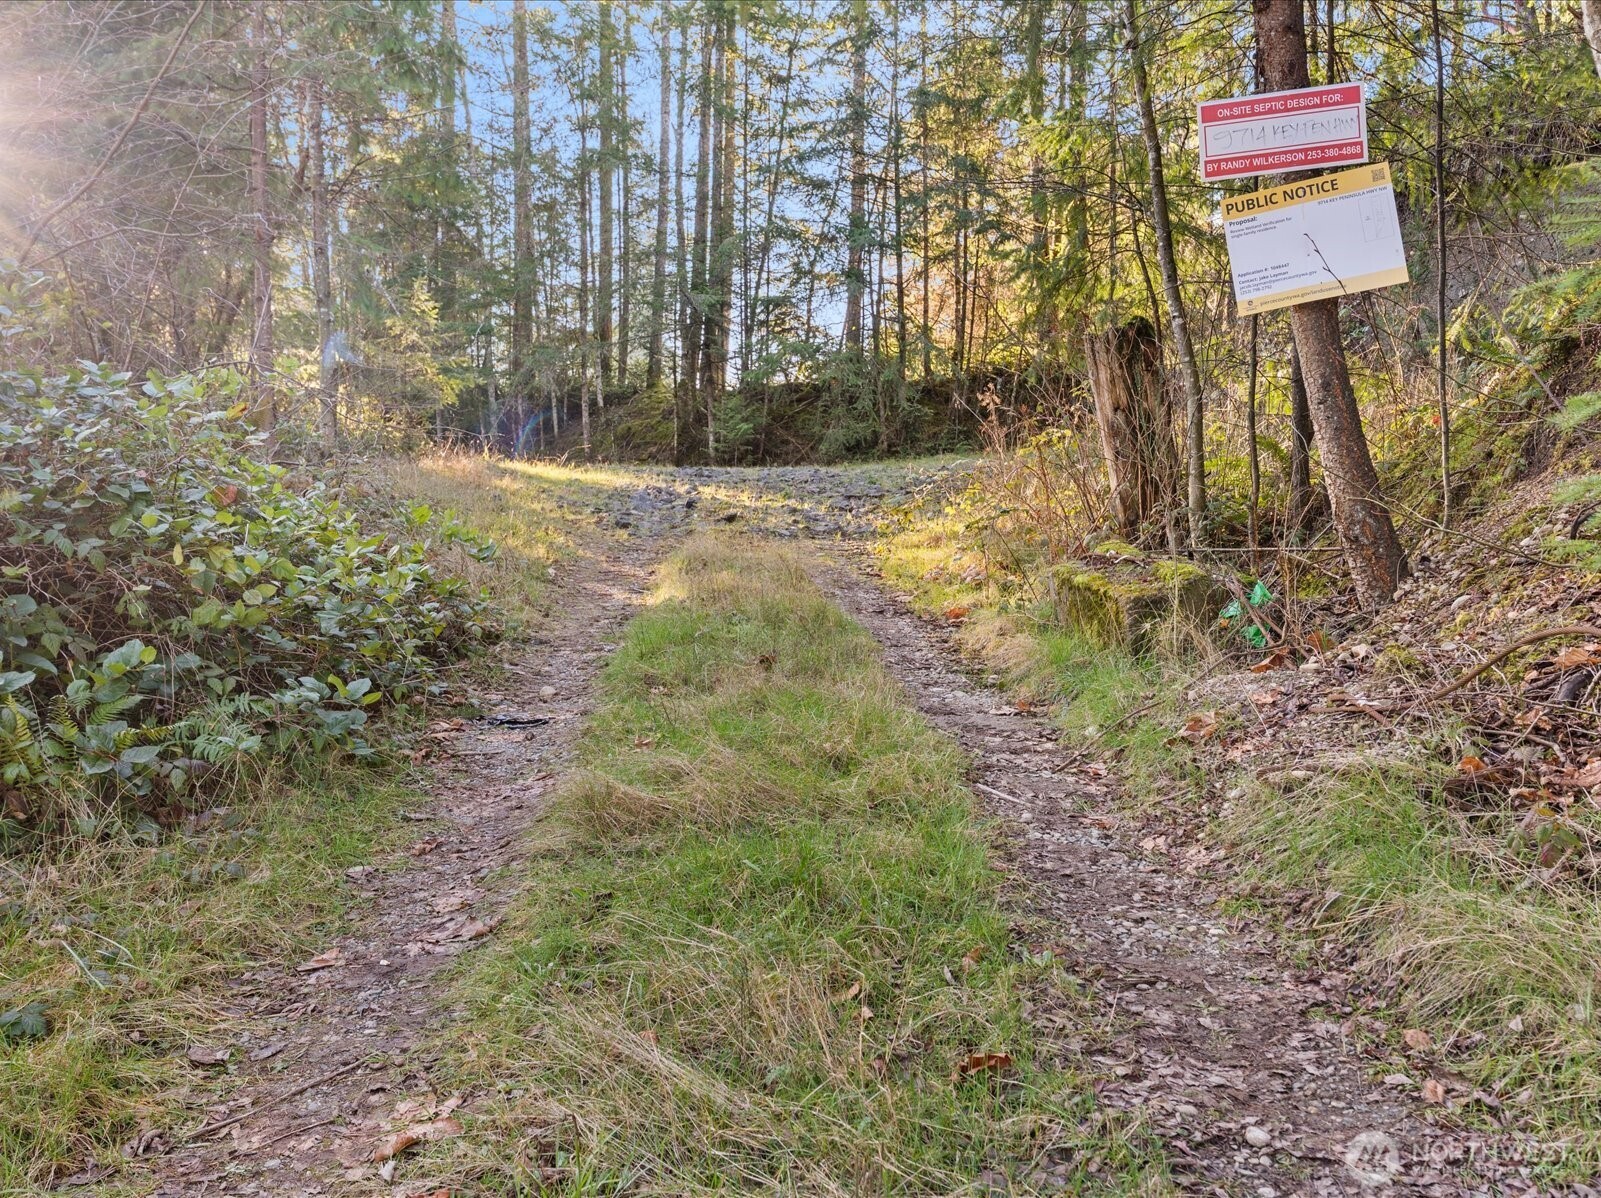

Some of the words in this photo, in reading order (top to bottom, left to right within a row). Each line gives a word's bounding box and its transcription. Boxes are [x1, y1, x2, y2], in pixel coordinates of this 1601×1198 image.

[1218, 105, 1252, 118] ON-SITE
[1254, 100, 1285, 113] SEPTIC
[1287, 96, 1320, 108] DESIGN
[1322, 93, 1344, 104] FOR:
[1207, 162, 1218, 172] BY
[1220, 158, 1250, 170] RANDY
[1252, 152, 1304, 166] WILKERSON
[1307, 145, 1362, 159] 253-380-4868
[1226, 192, 1279, 216] PUBLIC
[1283, 178, 1339, 202] NOTICE
[1339, 192, 1366, 200] PENINSULA
[1228, 216, 1258, 227] Proposal:
